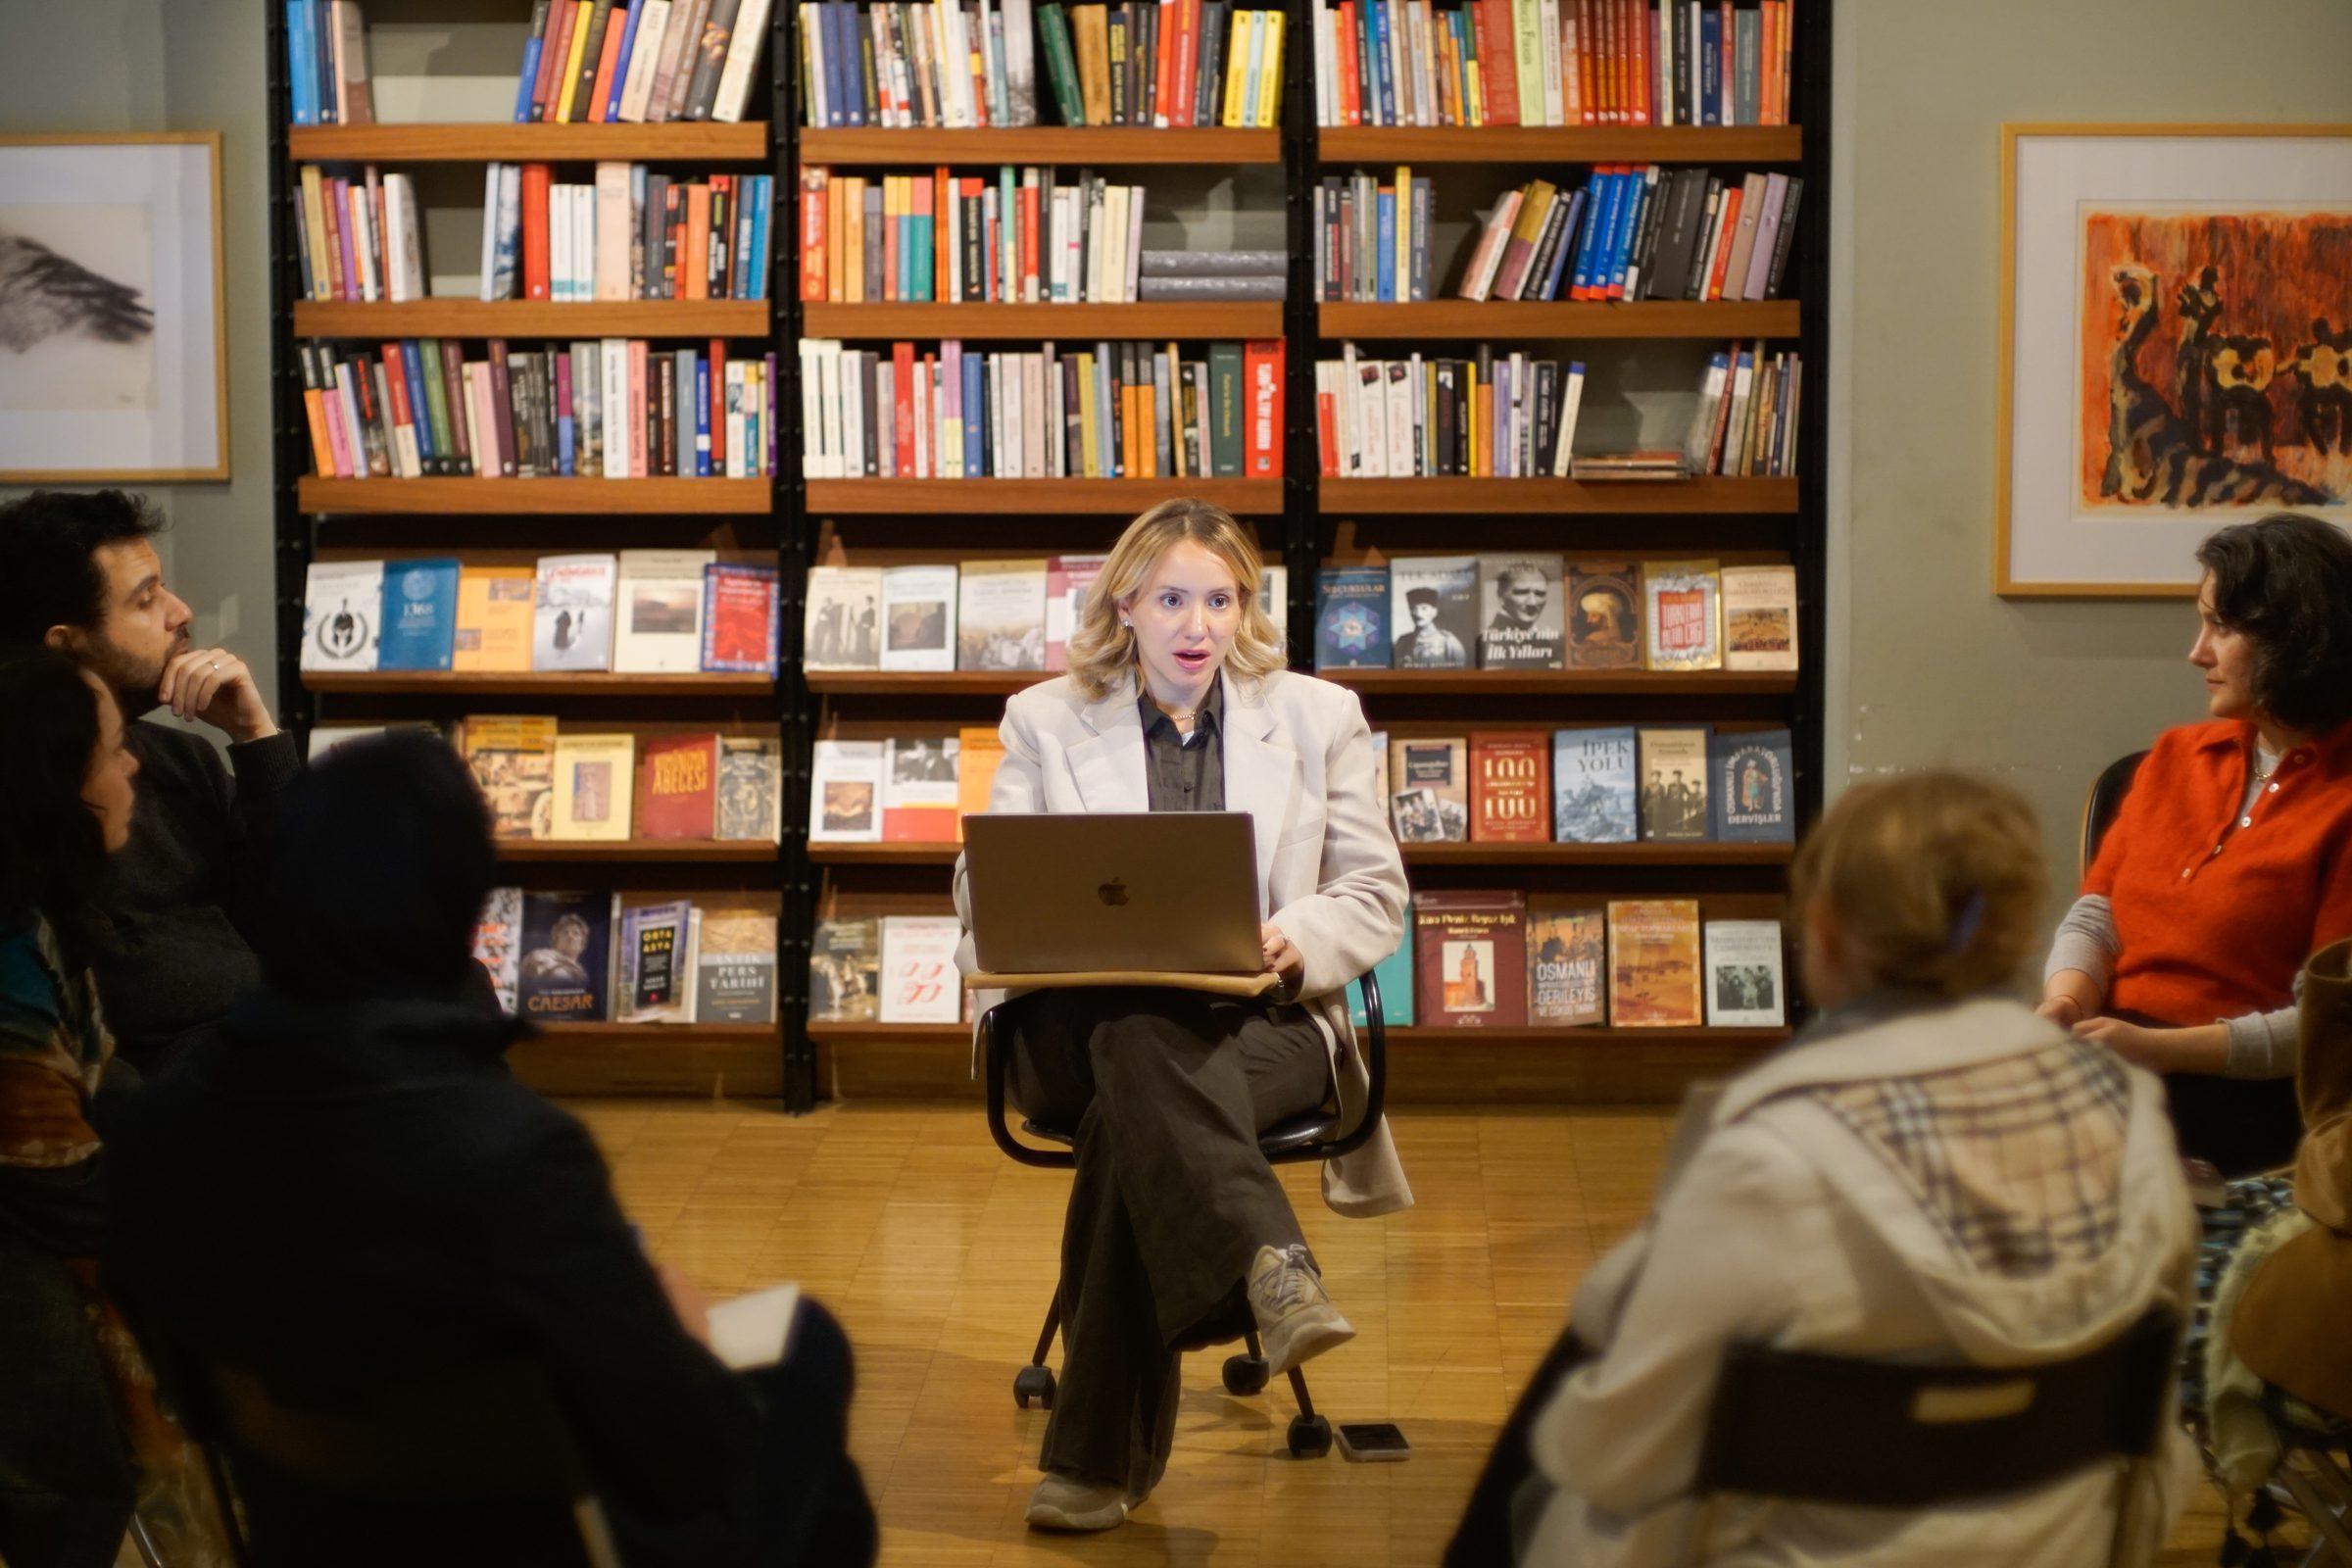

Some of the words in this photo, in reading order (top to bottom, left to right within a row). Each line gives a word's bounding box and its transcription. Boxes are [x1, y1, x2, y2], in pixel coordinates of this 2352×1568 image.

[1481, 625, 1560, 644] Türkiye'nin
[1509, 644, 1553, 660] Yılları
[1728, 812, 1783, 825] DERVİŞLER
[527, 994, 594, 1011] CAESAR
